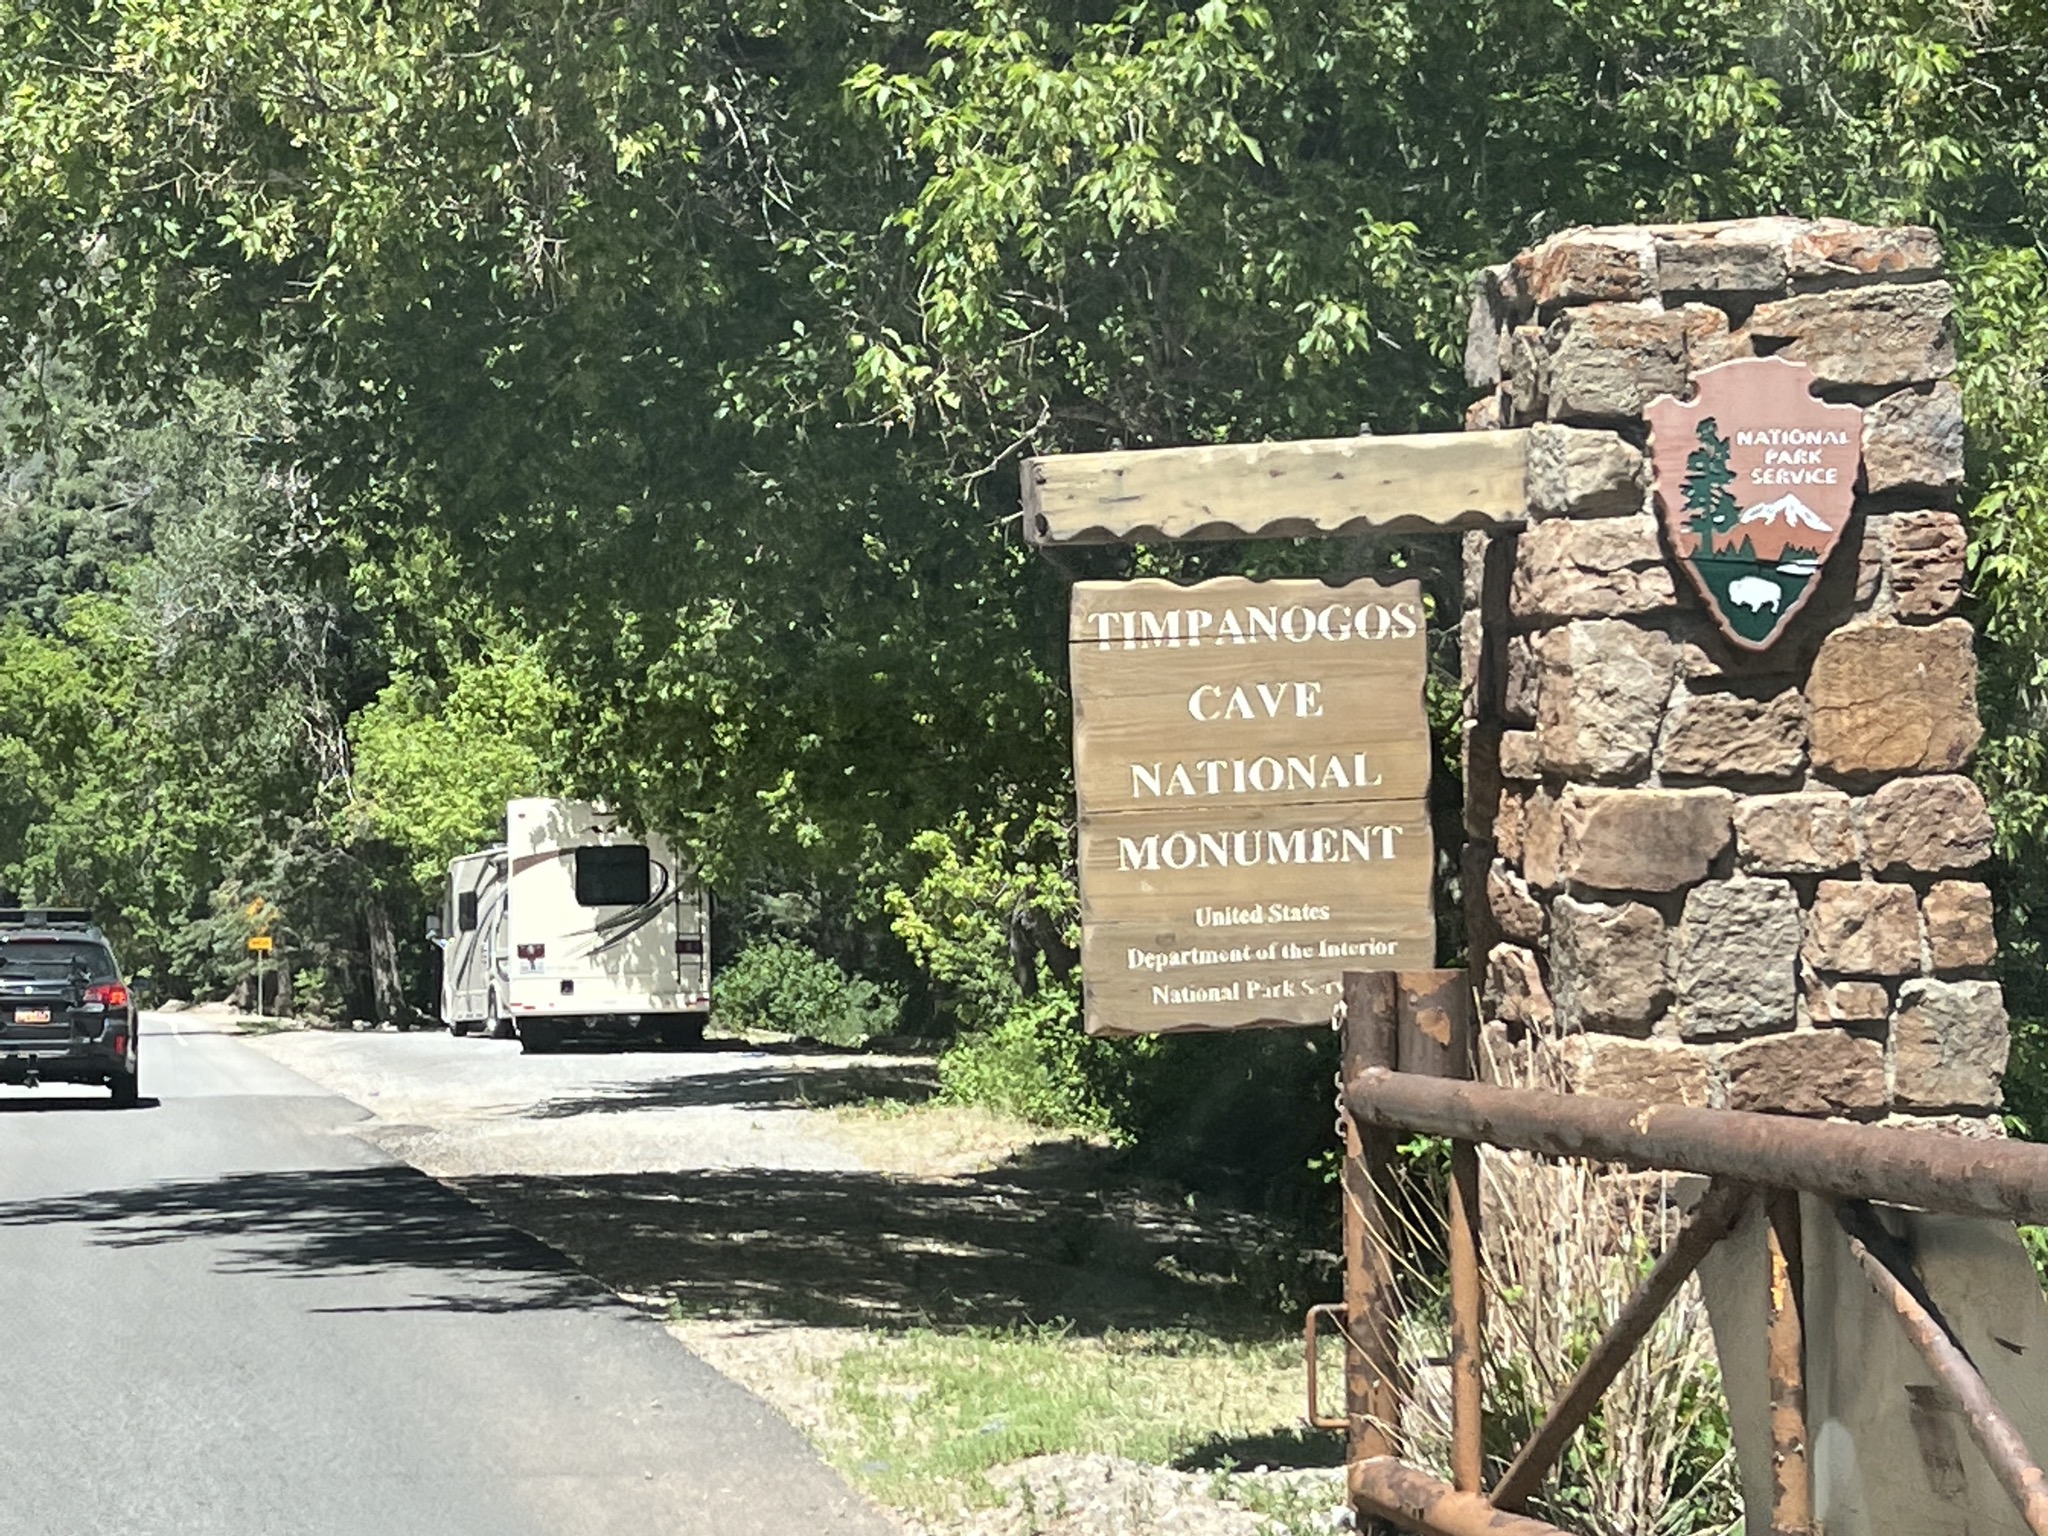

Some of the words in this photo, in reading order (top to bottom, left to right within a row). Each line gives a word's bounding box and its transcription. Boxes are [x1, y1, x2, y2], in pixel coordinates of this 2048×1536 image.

[1737, 428, 1849, 445] NATIONAL
[1765, 449, 1822, 464] PARK
[1751, 468, 1837, 484] SERVICE
[1088, 602, 1417, 650] TIMPANOGOS
[1188, 681, 1323, 721] CAVE
[1130, 752, 1382, 798] NATIONAL
[1117, 825, 1403, 871] MONUMENT
[1195, 904, 1263, 927] United
[1267, 902, 1330, 923] States
[1127, 945, 1250, 971] Department
[1256, 942, 1277, 960] of
[1281, 941, 1313, 960] the
[1318, 936, 1398, 958] Interior
[1152, 981, 1239, 1005] National
[1246, 979, 1295, 999] Park
